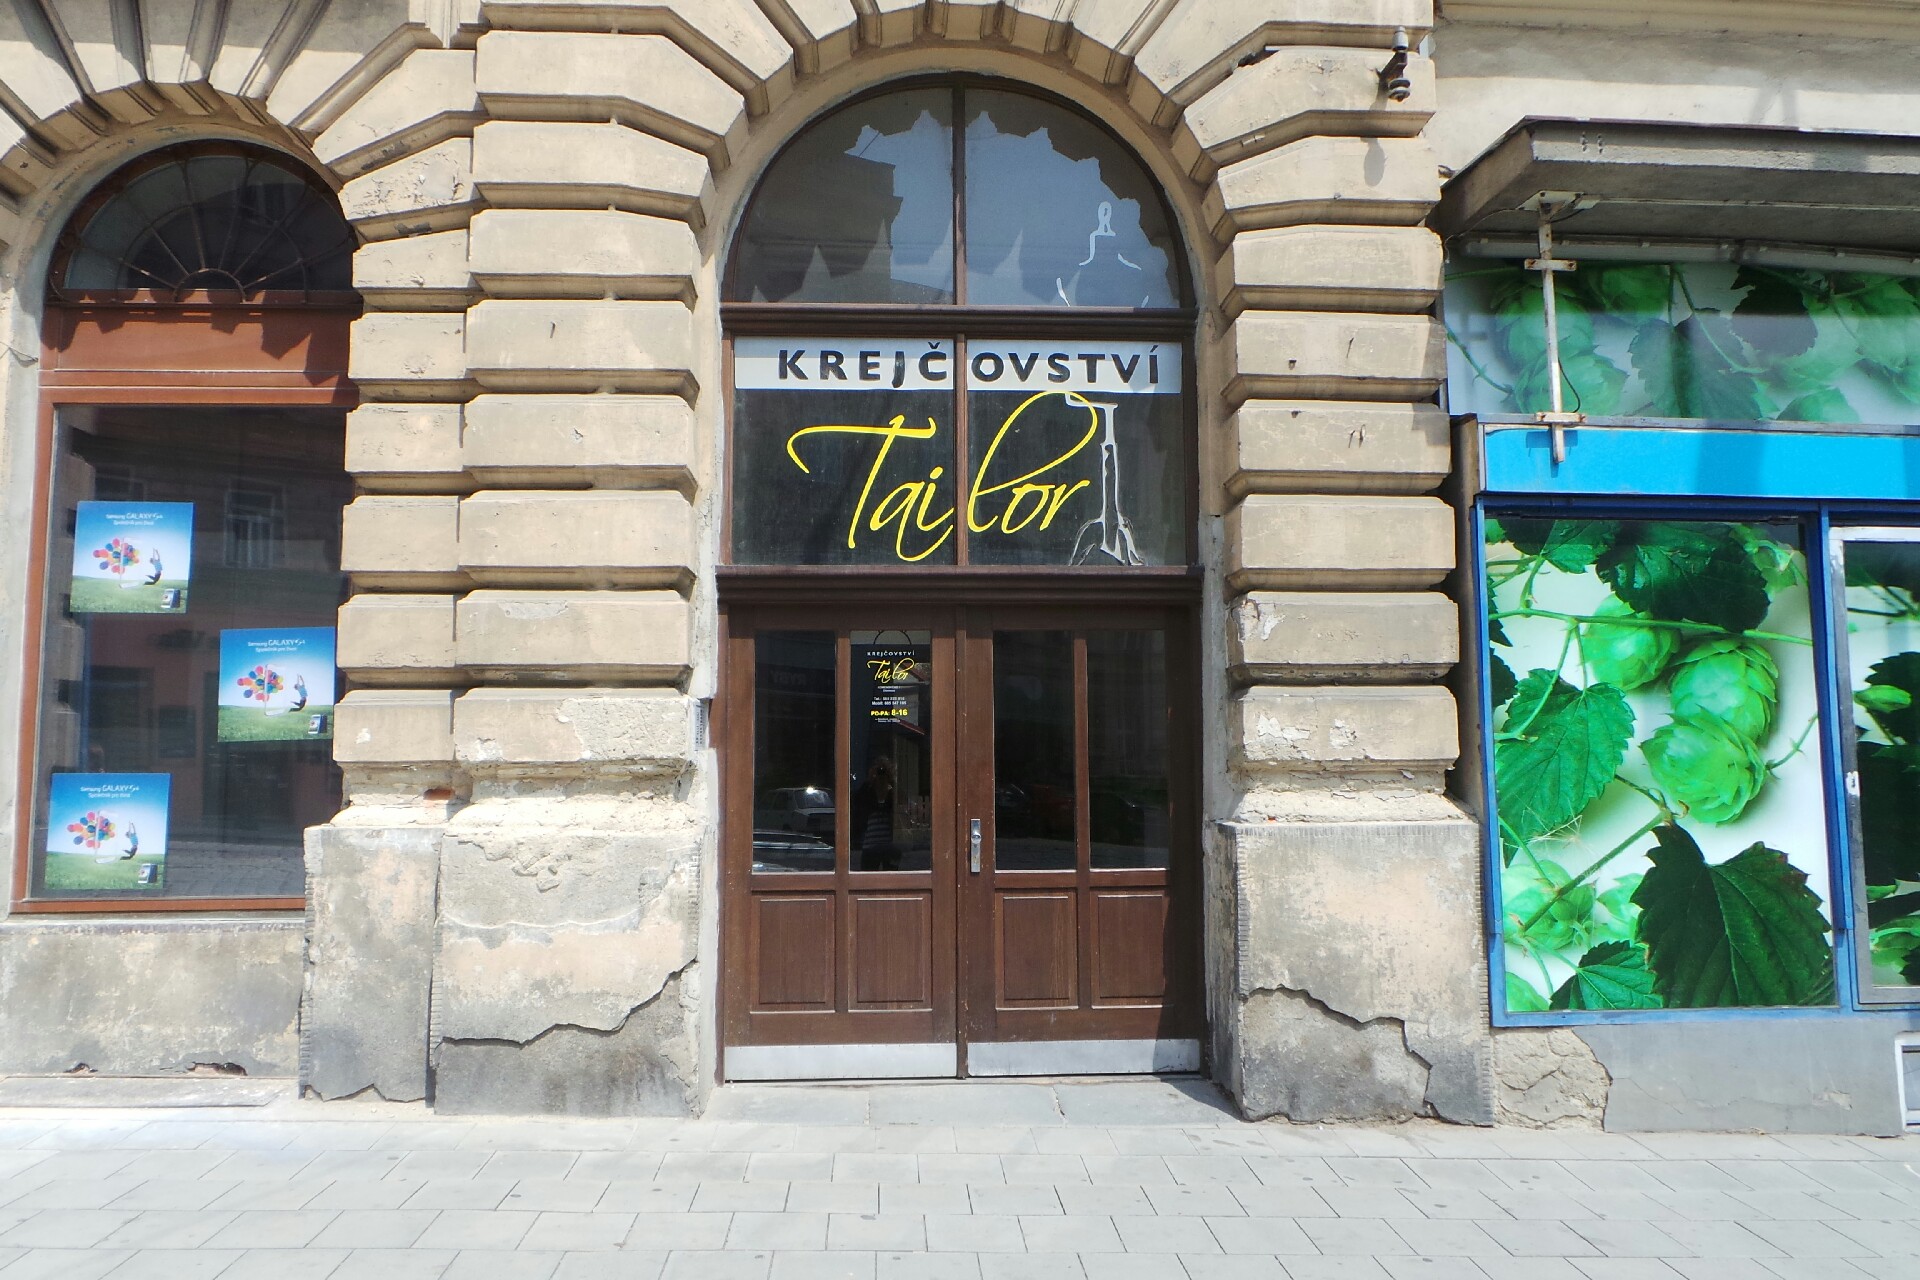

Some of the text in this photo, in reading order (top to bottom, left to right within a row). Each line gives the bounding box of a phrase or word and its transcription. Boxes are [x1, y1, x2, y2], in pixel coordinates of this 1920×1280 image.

[778, 341, 1159, 389] KREJČOVSTVÍ
[786, 390, 1098, 562] Tailor
[126, 512, 152, 520] GALAXY
[867, 657, 914, 684] Tailor
